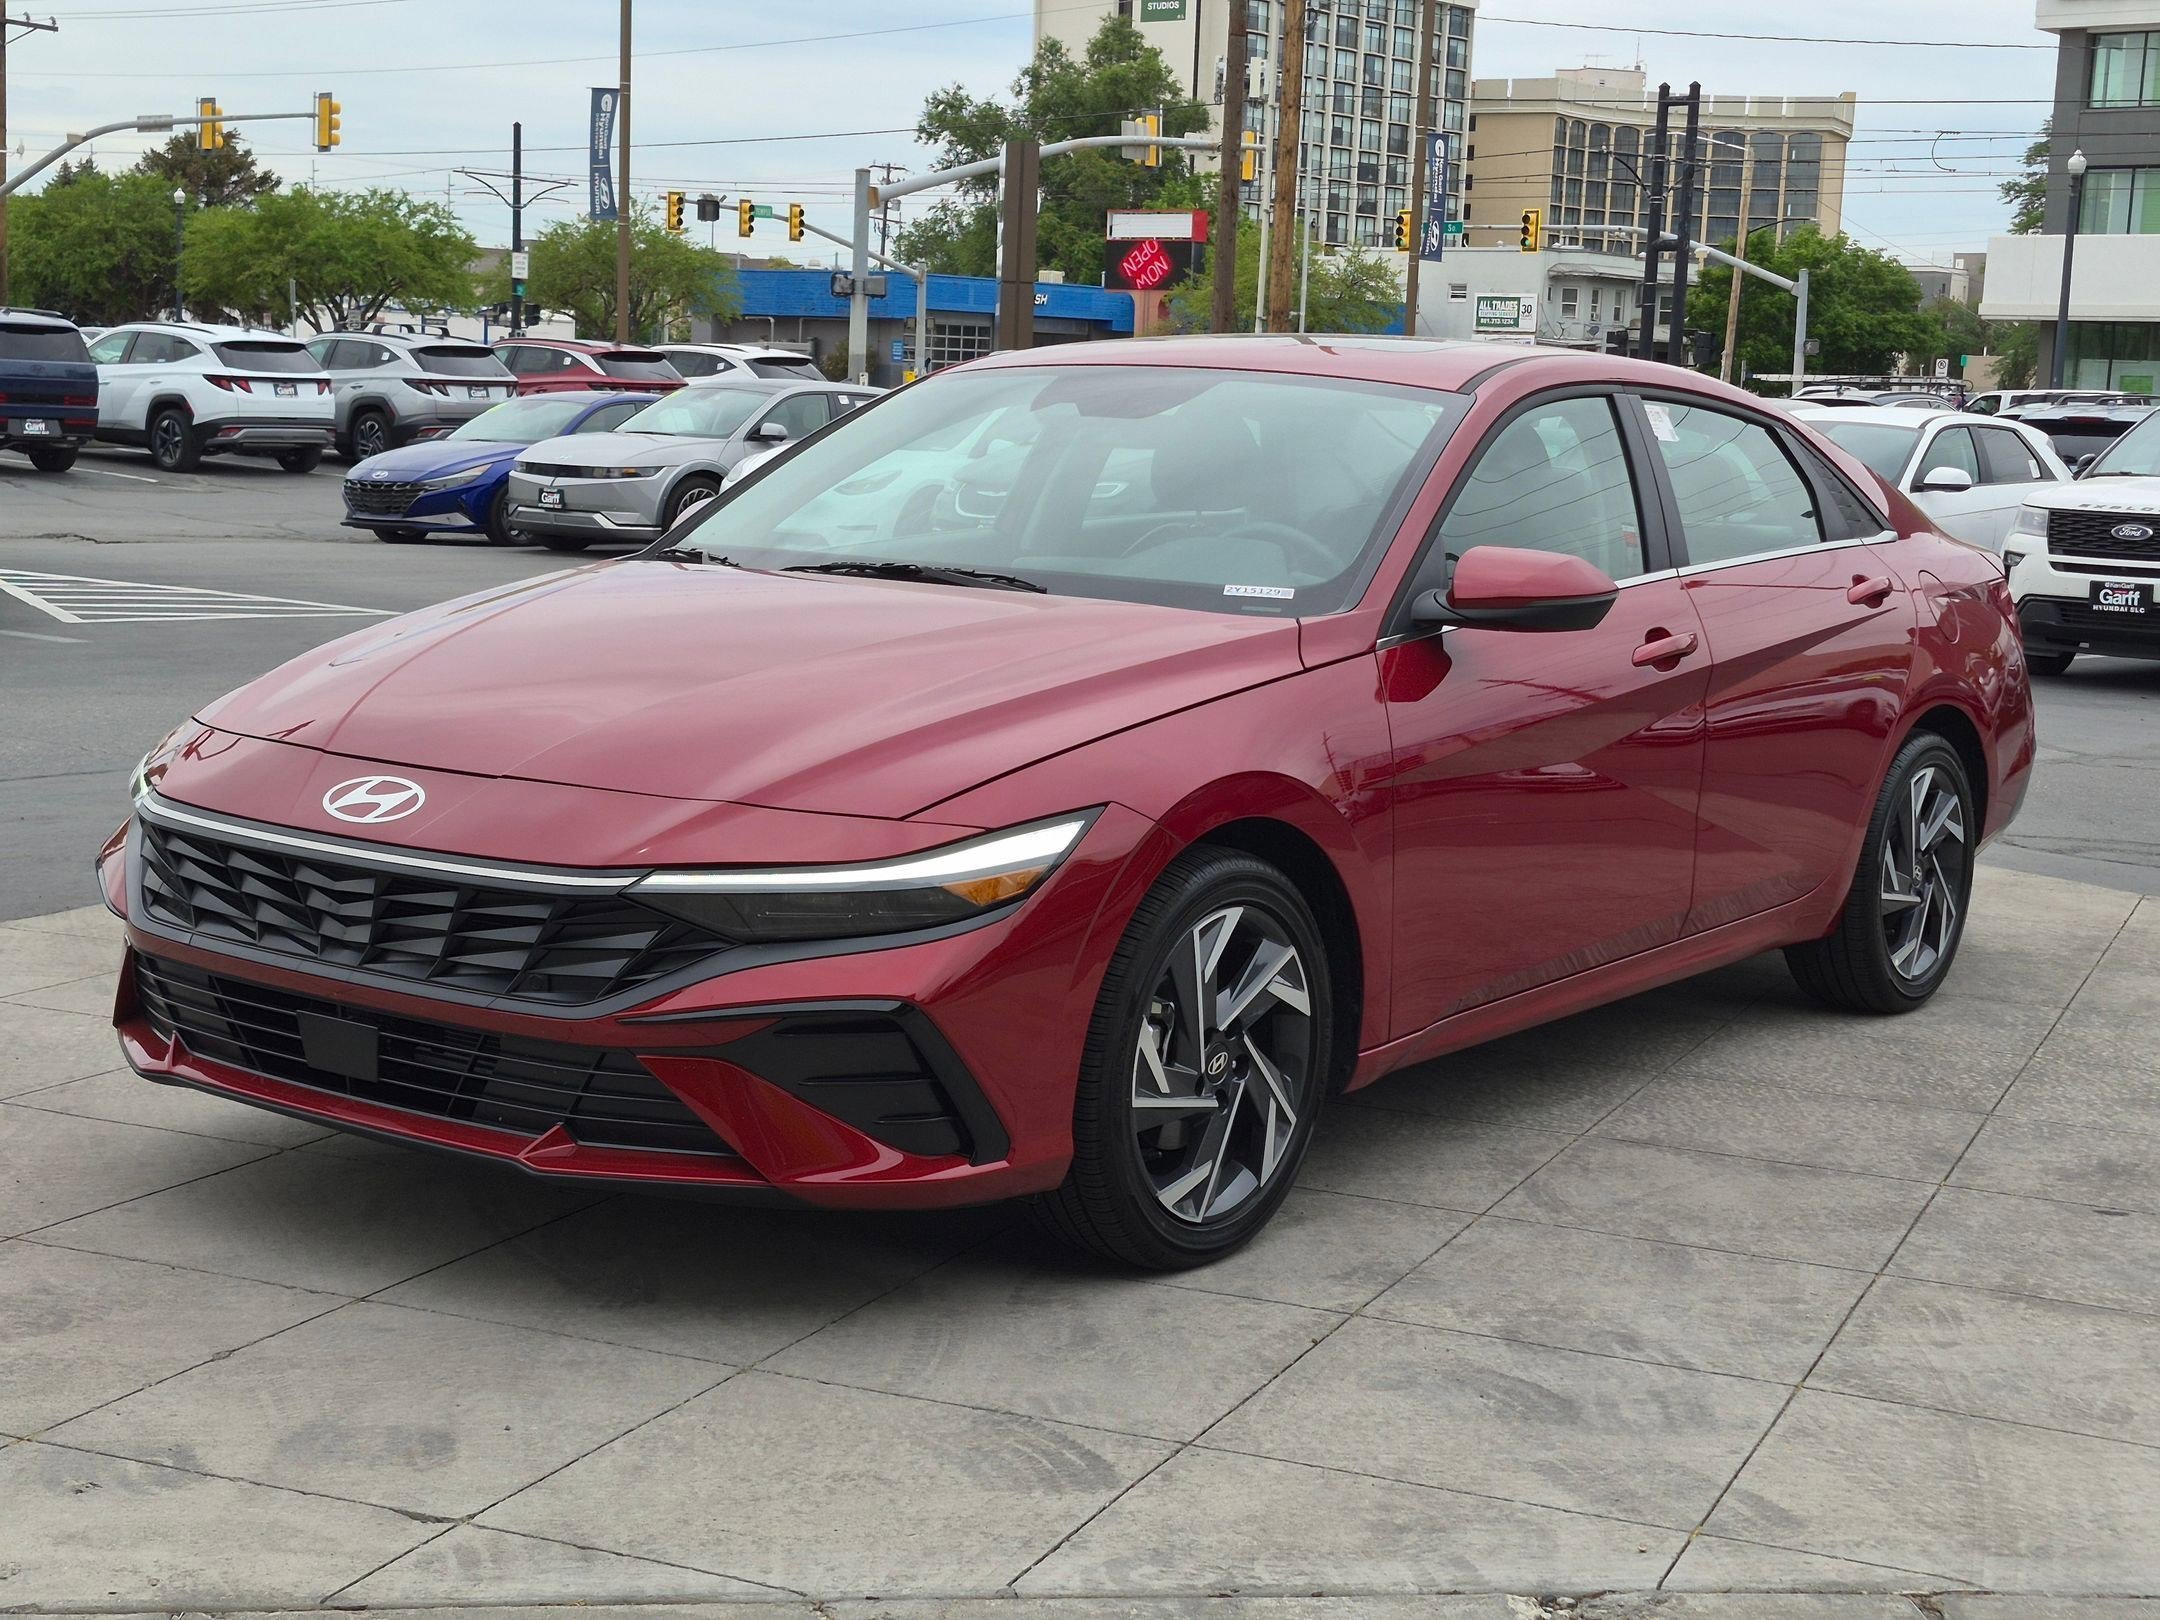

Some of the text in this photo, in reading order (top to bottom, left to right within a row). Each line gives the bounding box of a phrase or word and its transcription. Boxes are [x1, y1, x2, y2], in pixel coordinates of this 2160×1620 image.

[1147, 1, 1180, 10] STUDIOS
[1123, 240, 1158, 277] OPEN
[1136, 256, 1168, 289] NOW
[1034, 294, 1048, 305] SH
[1479, 300, 1518, 310] ALL TRADES
[1521, 304, 1533, 314] 30
[541, 492, 561, 504] Garff
[2078, 503, 2160, 513] EXPLO
[2118, 525, 2143, 538] Ford
[2099, 588, 2141, 606] Garff
[2092, 604, 2128, 612] HYUNDAI
